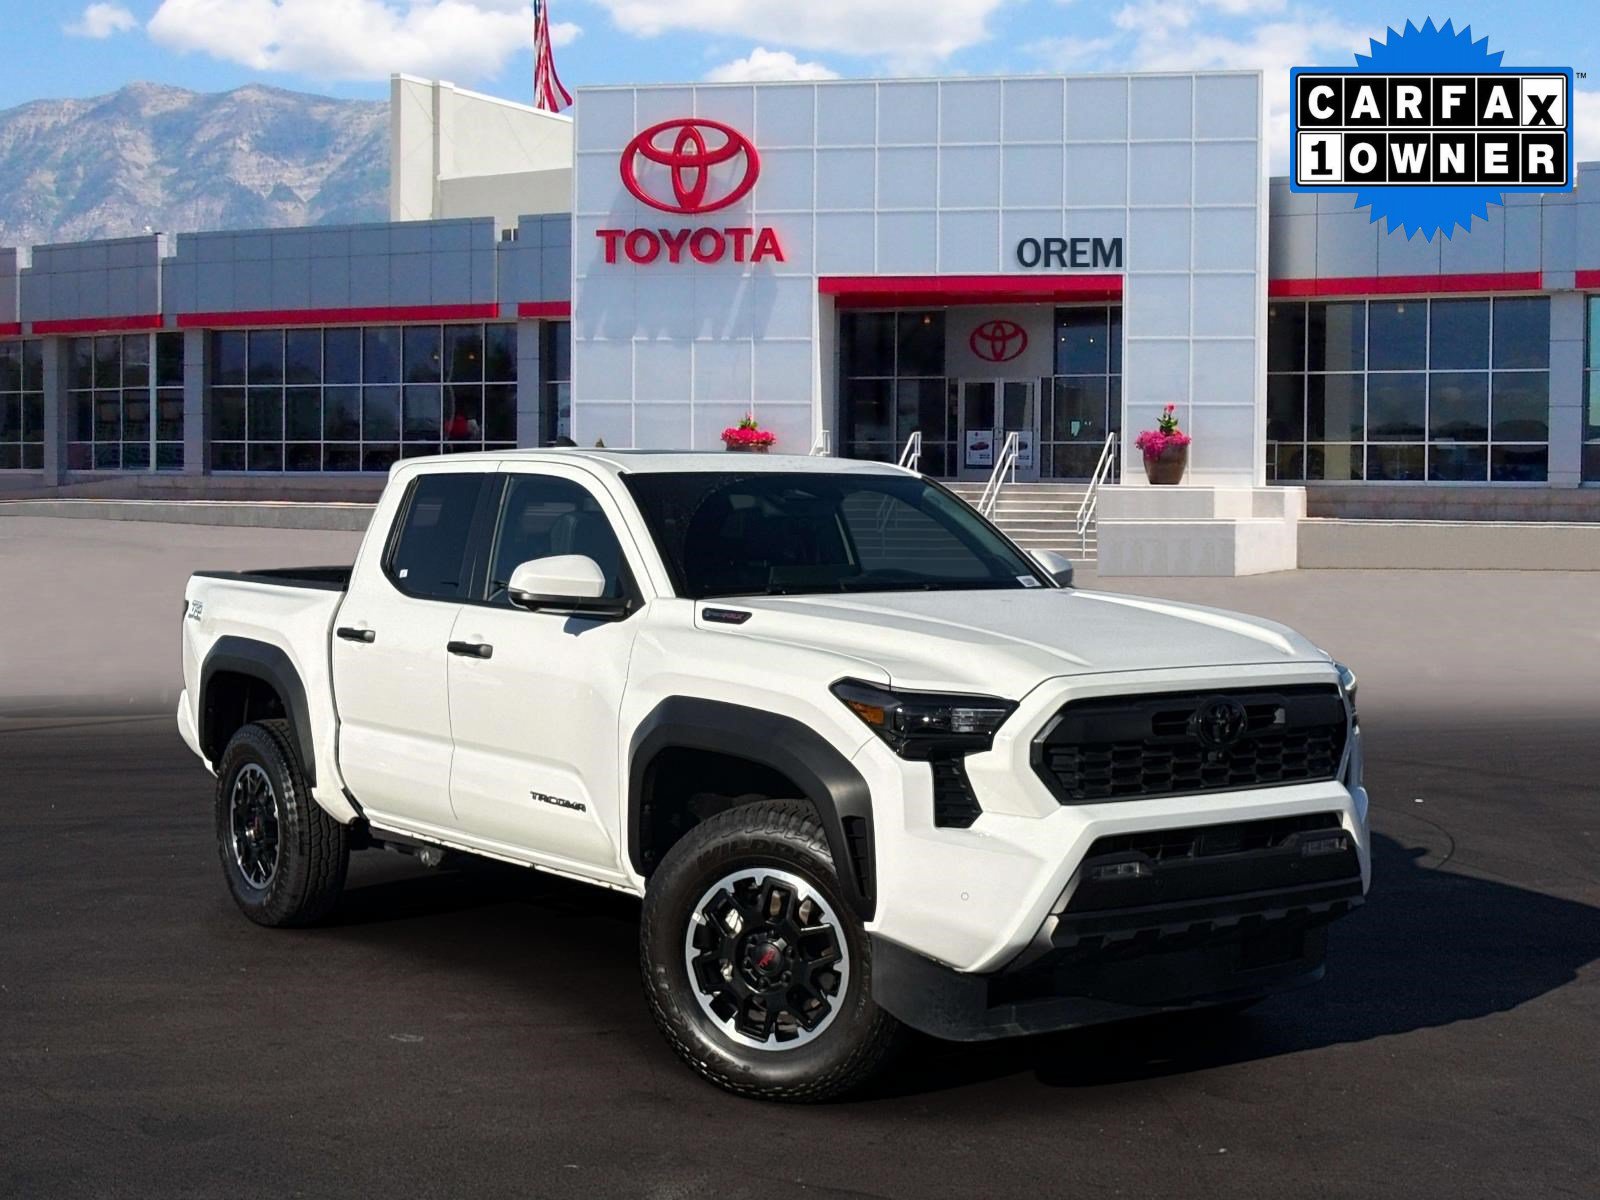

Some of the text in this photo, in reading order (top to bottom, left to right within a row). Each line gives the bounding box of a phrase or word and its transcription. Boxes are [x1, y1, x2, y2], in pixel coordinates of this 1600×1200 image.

[596, 227, 785, 264] TOYOTA
[1017, 237, 1122, 268] OREM
[530, 791, 587, 813] TACOMA
